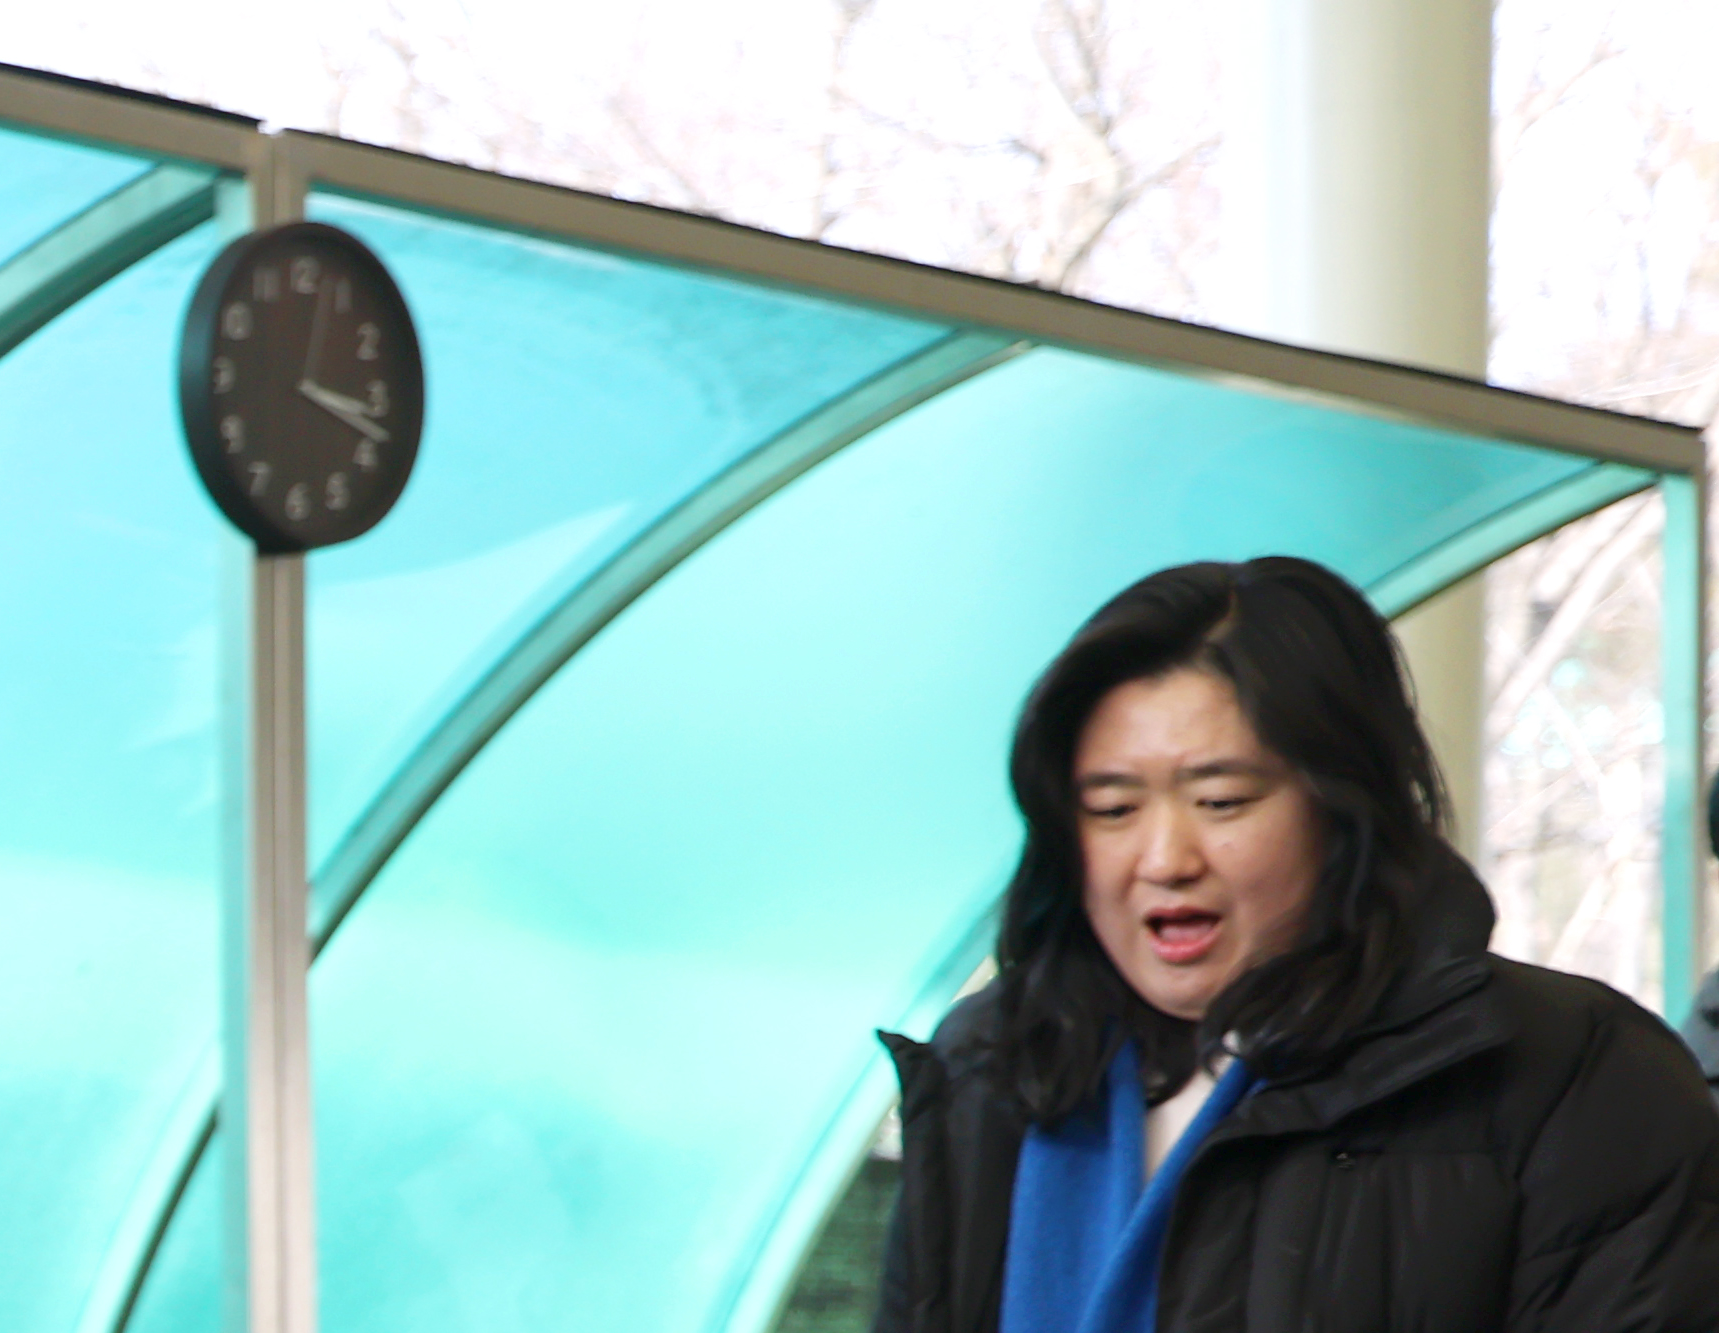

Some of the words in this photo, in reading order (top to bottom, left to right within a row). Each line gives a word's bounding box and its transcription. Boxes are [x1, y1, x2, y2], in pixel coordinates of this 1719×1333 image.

[356, 321, 381, 361] 2
[366, 379, 390, 418] 3
[247, 460, 272, 497] 7
